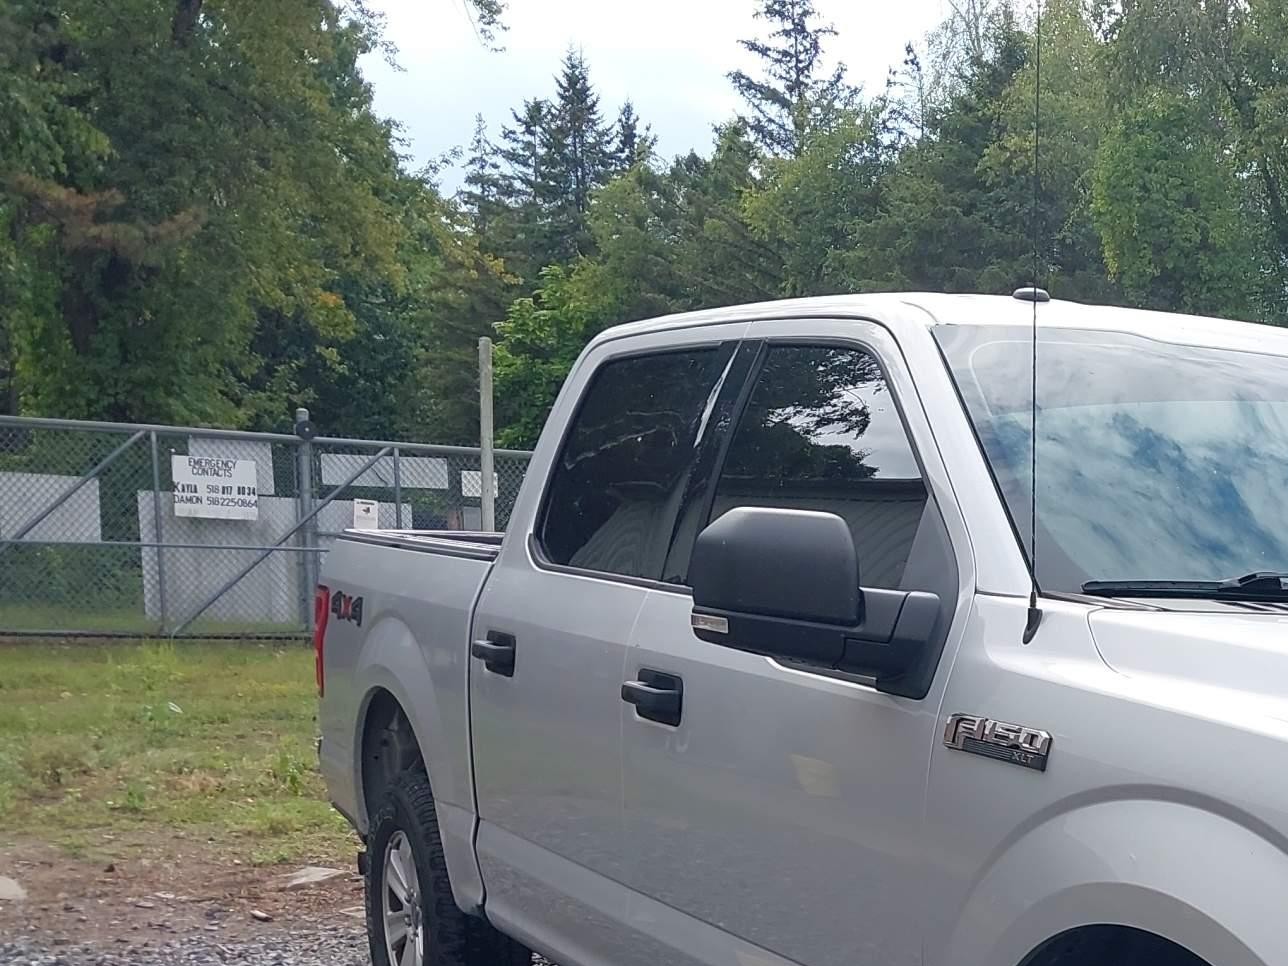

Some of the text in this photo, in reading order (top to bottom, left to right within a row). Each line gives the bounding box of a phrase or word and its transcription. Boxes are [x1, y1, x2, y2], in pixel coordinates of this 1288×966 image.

[188, 457, 237, 470] EMERGENCY
[191, 466, 233, 478] CONTACTS
[207, 484, 220, 495] 518
[173, 495, 203, 505] DAMON
[206, 496, 220, 506] 518
[1012, 751, 1035, 764] XLT
